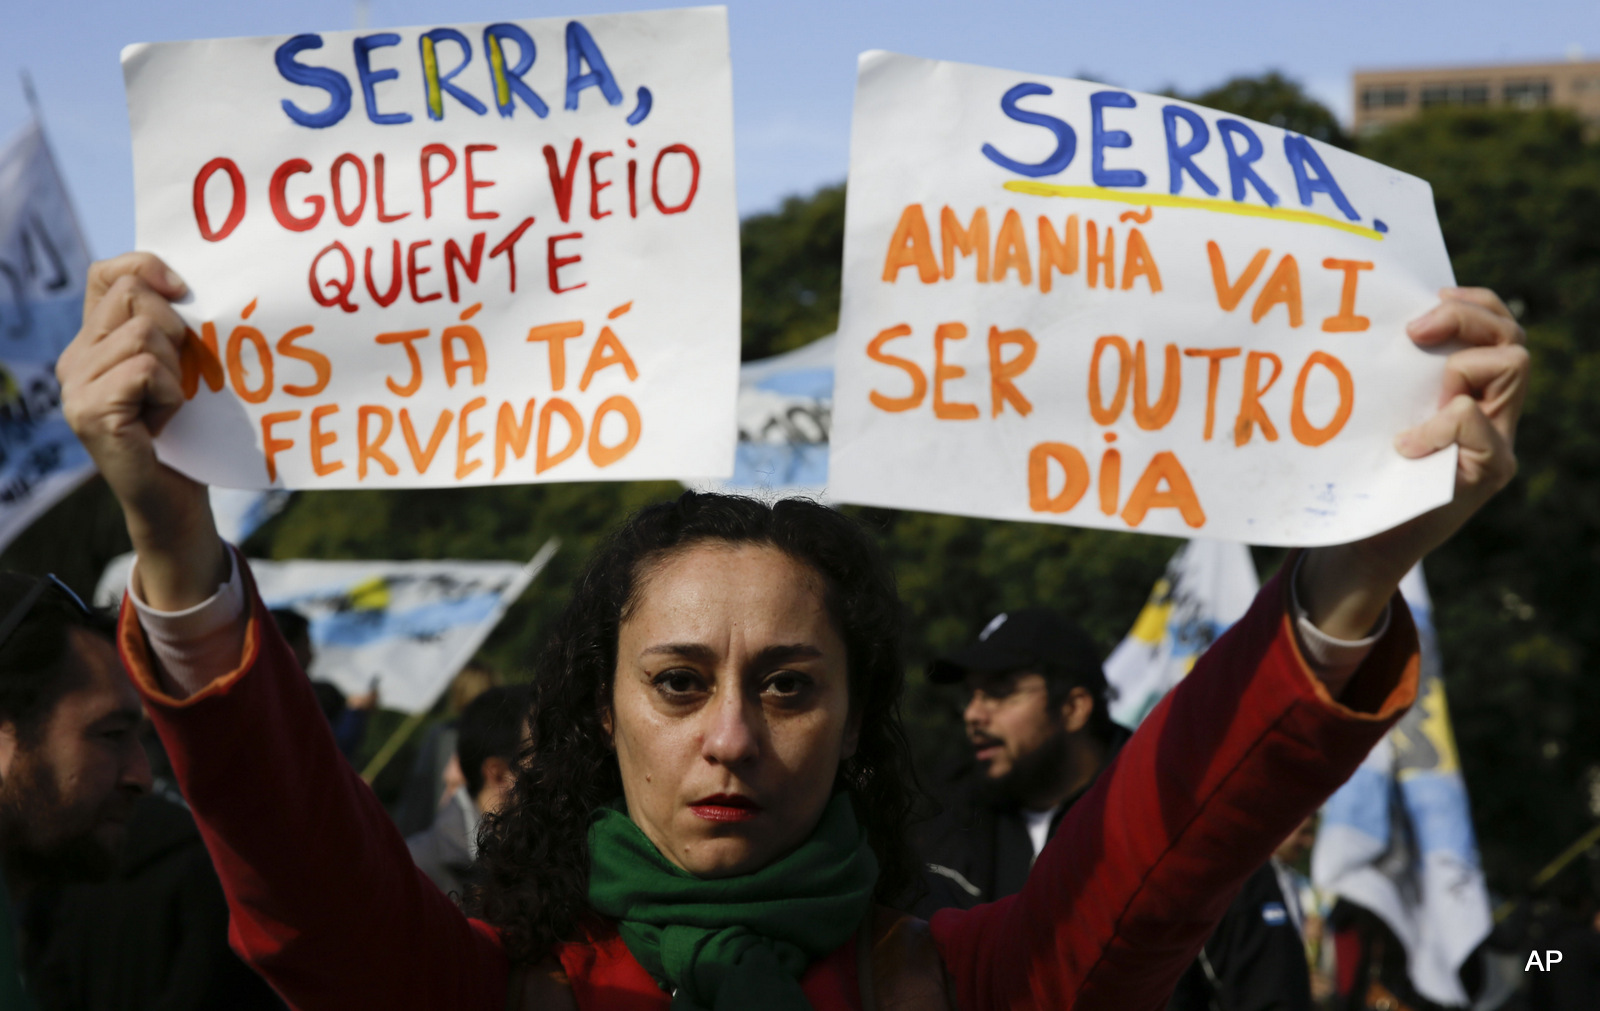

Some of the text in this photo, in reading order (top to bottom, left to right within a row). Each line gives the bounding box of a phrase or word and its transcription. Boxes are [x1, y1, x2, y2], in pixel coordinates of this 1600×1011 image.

[275, 21, 653, 129] SERRA,
[192, 157, 247, 242] O
[268, 143, 500, 233] GOLPE
[981, 82, 1389, 234] SERRA.
[308, 216, 588, 313] QUENTE
[881, 203, 1375, 334] AMANHÃ VAI
[179, 297, 639, 404] NÓS JÁ TÁ
[866, 321, 1355, 448] SER OUTRO
[260, 395, 642, 484] FERVENDO
